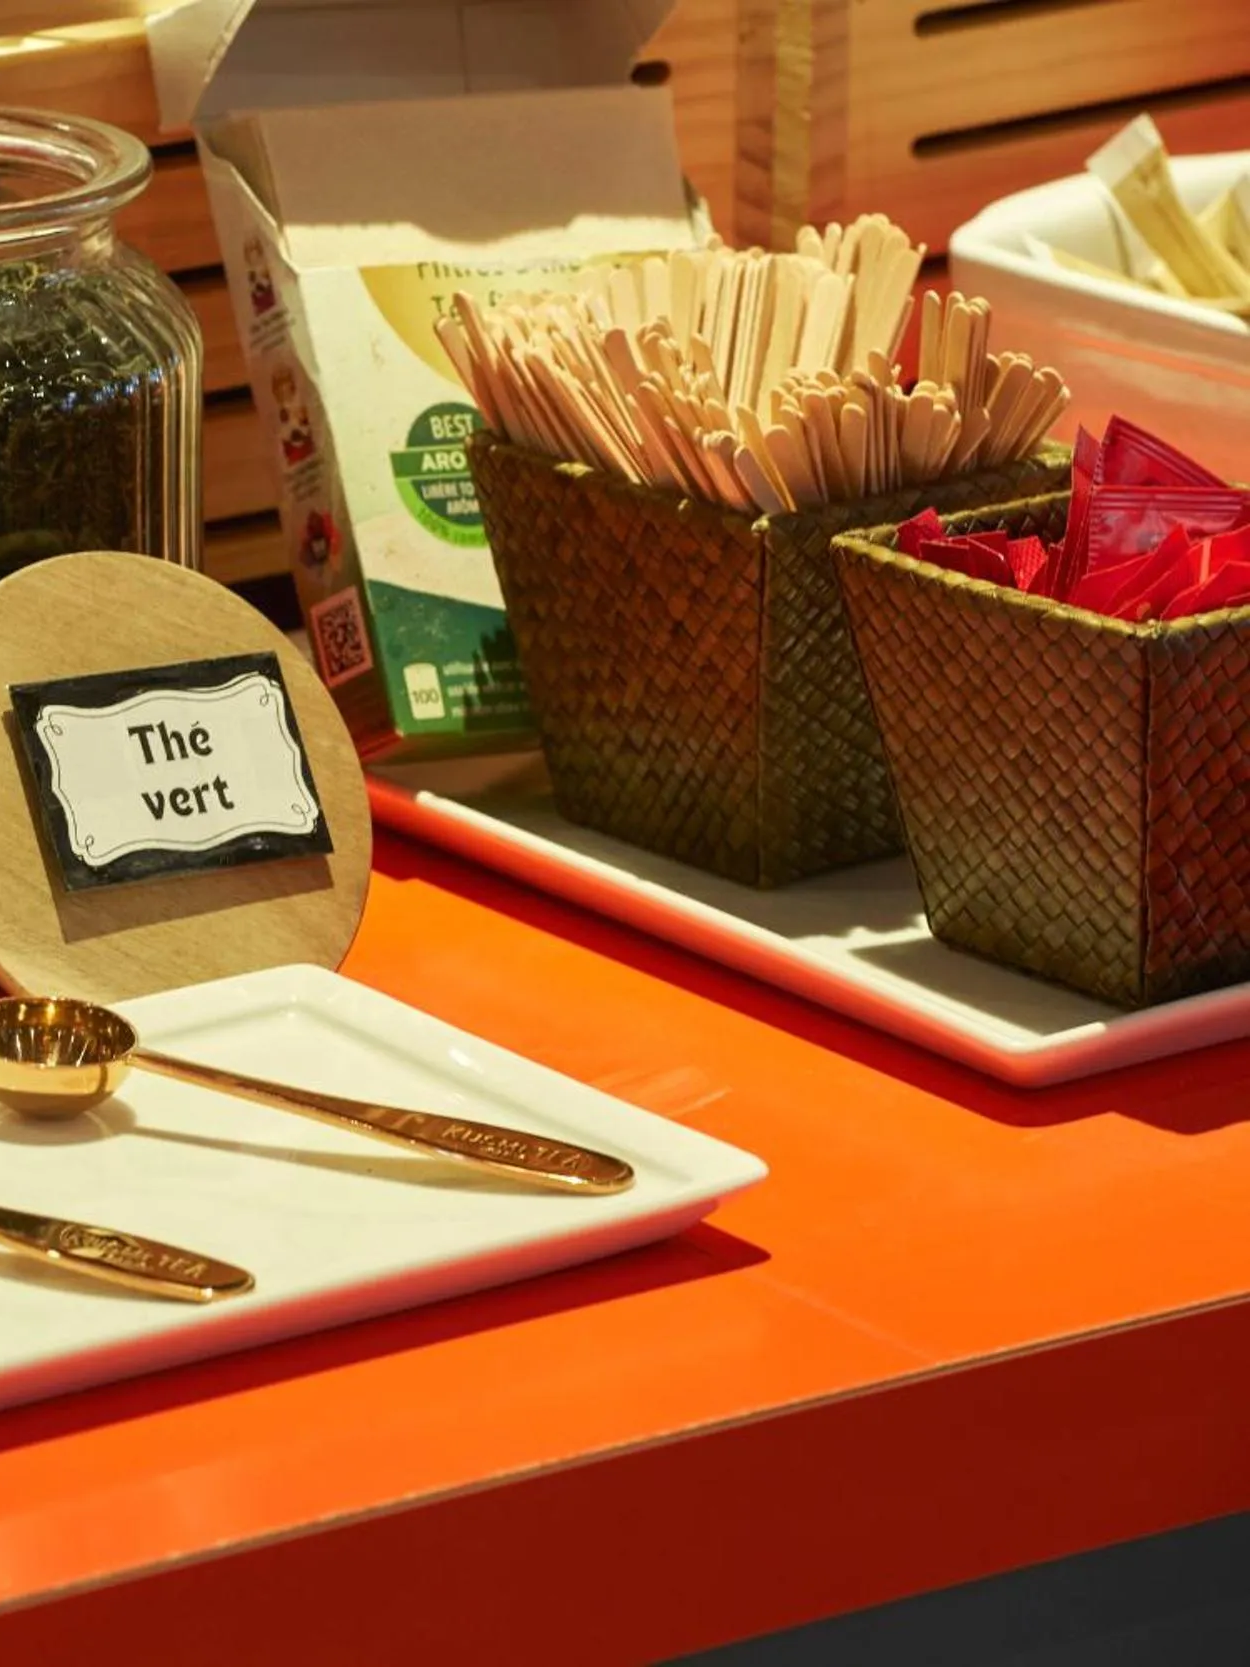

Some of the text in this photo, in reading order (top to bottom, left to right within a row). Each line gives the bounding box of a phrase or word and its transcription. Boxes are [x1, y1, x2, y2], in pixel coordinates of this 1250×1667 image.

[429, 414, 473, 439] BEST
[421, 451, 468, 472] ARO
[412, 688, 440, 704] 100
[127, 720, 213, 765] Thé
[141, 775, 235, 820] vert
